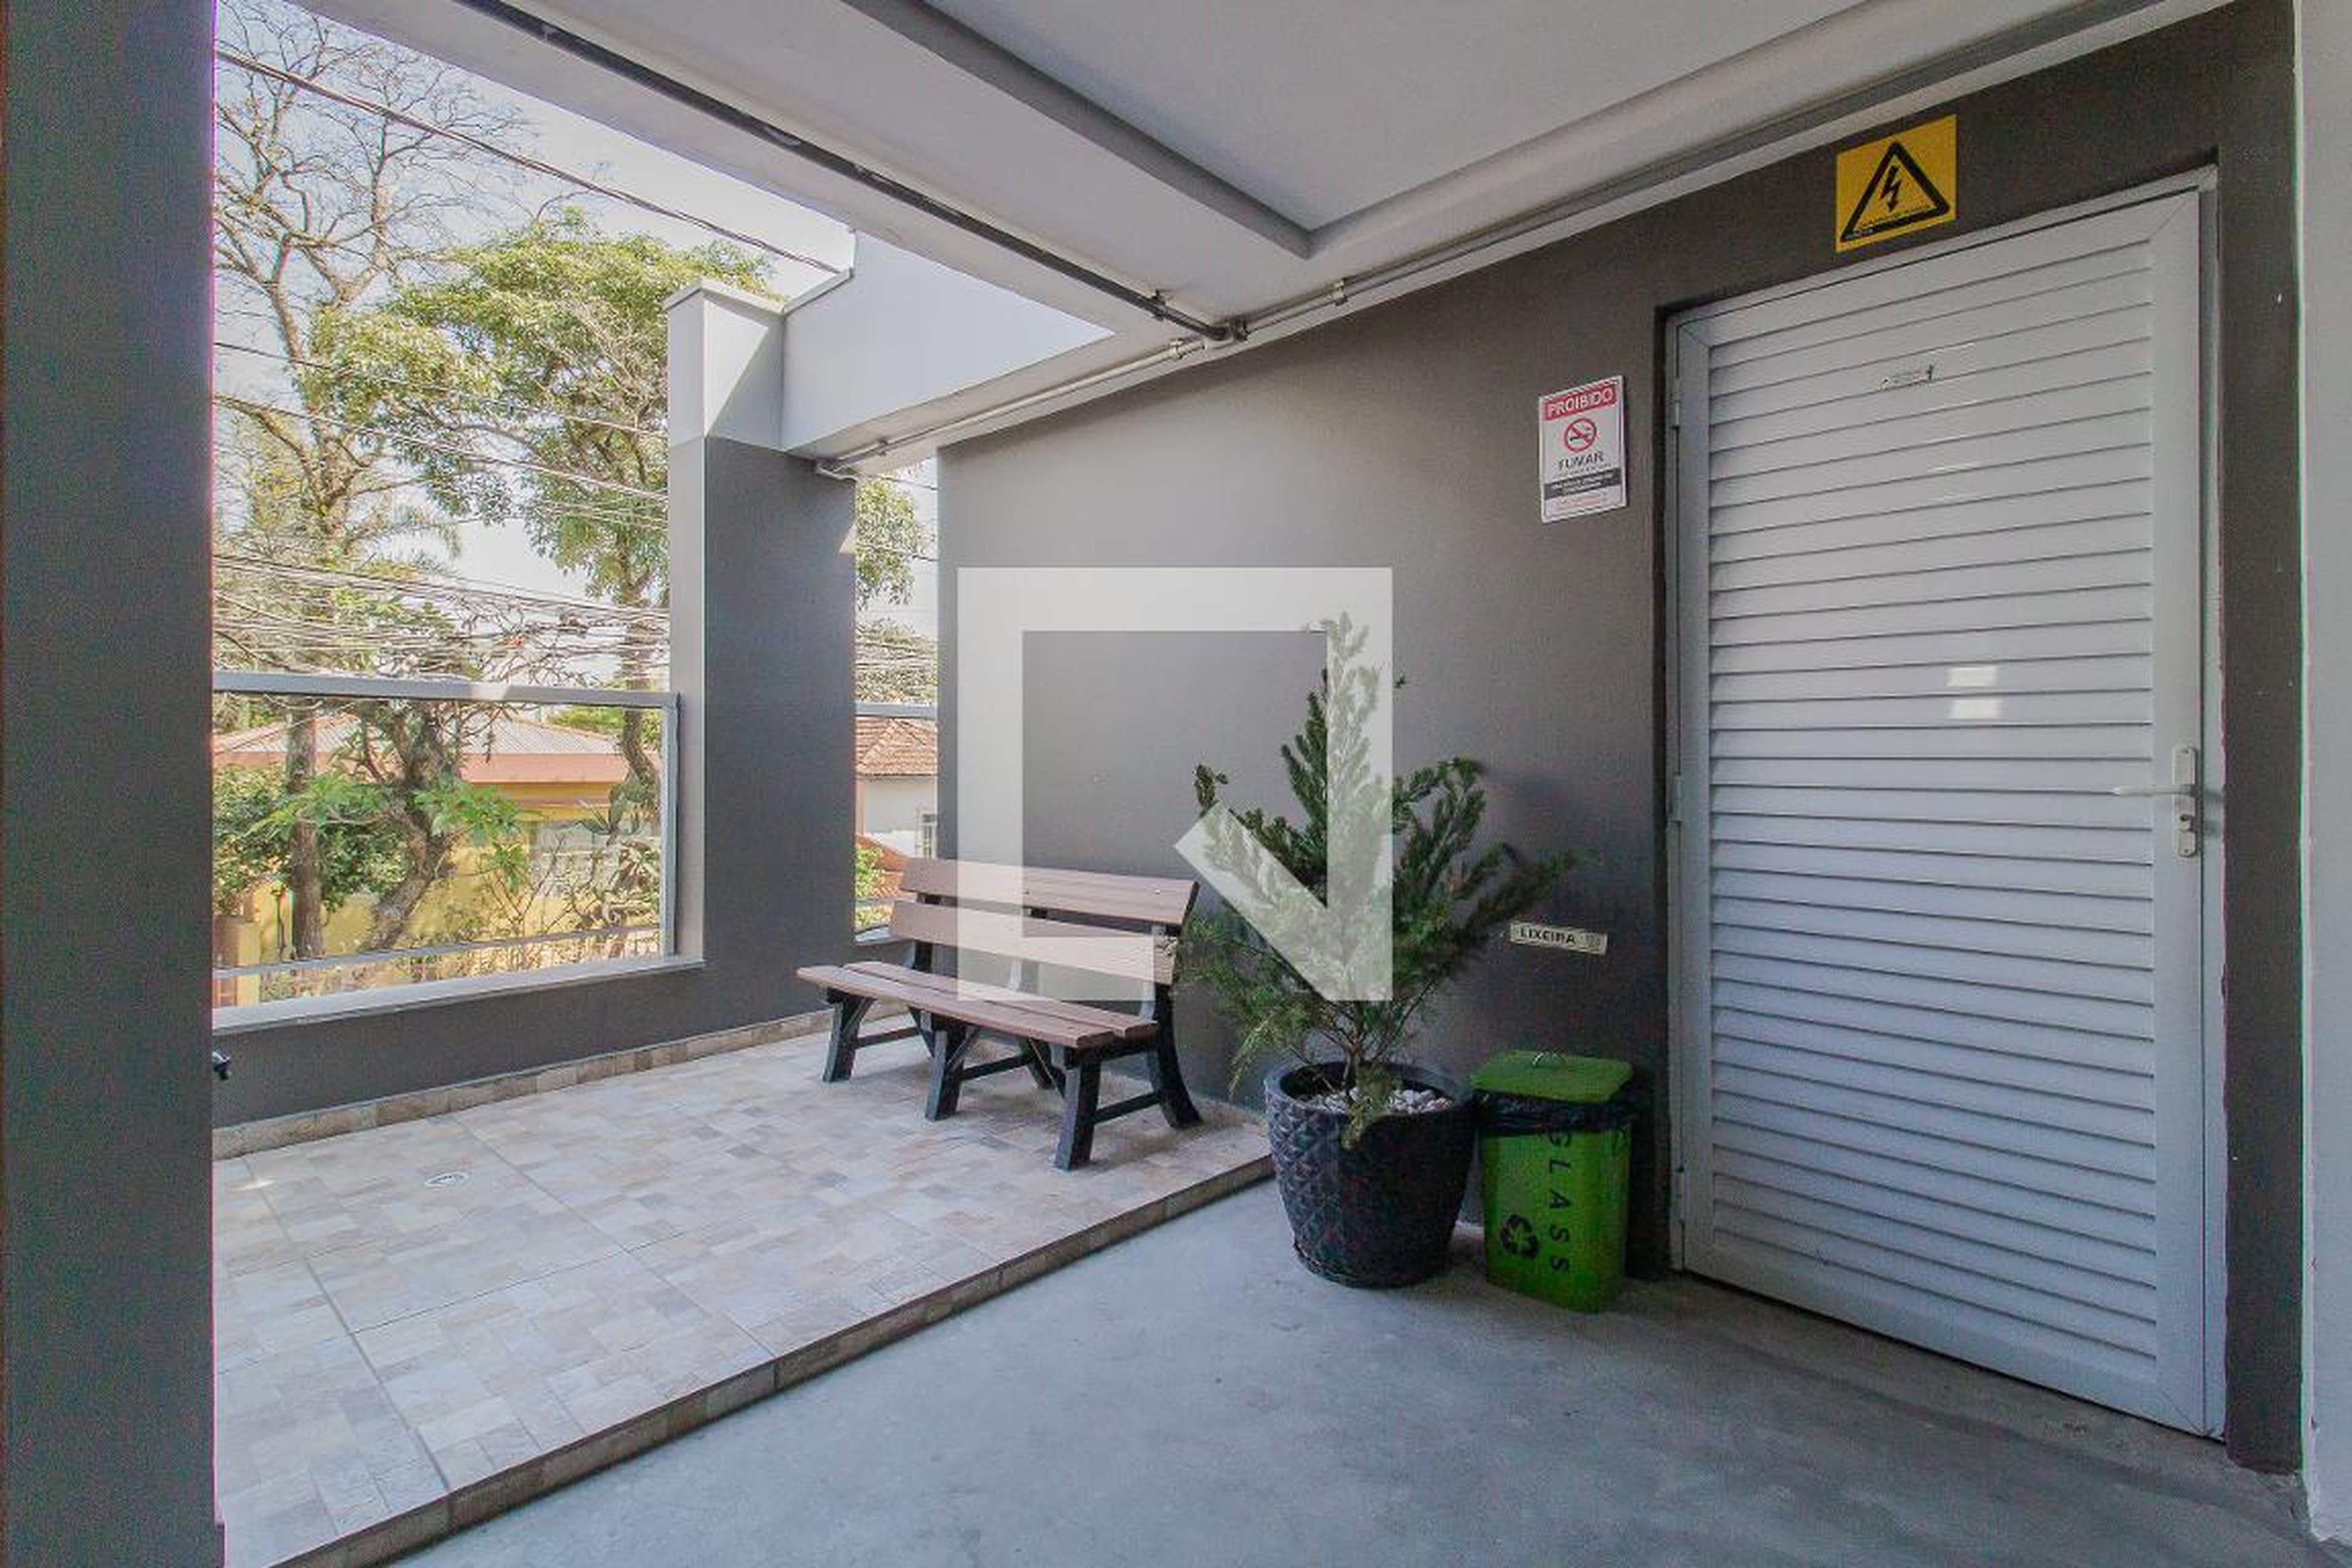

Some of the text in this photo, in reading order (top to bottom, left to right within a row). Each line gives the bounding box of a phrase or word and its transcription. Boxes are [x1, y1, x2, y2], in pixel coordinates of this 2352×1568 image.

[1547, 386, 1614, 417] PROIBIDO
[1558, 451, 1604, 471] FUMAR
[1520, 927, 1577, 943] LIXEIRA
